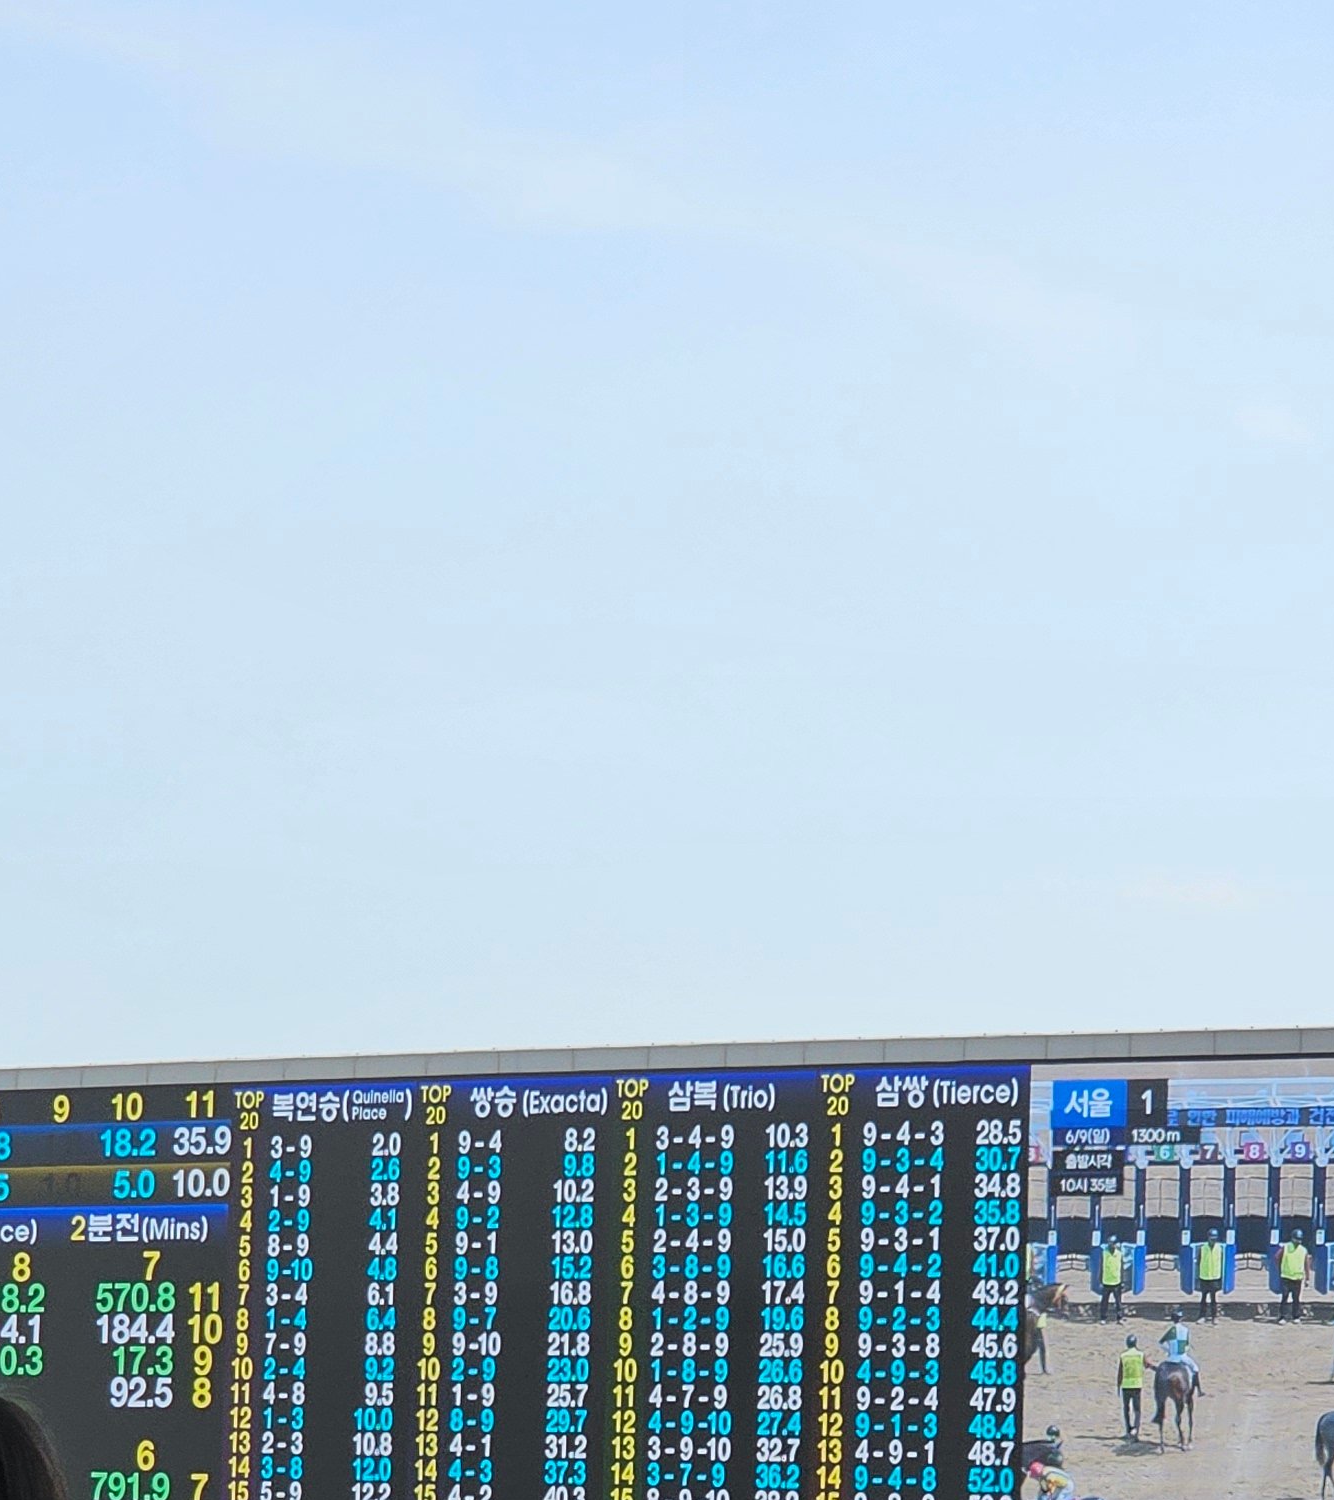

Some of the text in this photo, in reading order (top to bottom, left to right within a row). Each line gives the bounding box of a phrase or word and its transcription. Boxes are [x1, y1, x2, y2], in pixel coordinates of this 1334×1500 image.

[54, 1095, 70, 1123] 9
[112, 1092, 142, 1120] 10
[186, 1090, 213, 1118] 11
[235, 1091, 404, 1109] TOP Quinella
[471, 1087, 608, 1118] 쌍승 (Exacta)
[668, 1080, 775, 1112] 삼복 (Trio)
[875, 1076, 1019, 1108] 삼쌍 (Tierce)
[1064, 1089, 1152, 1118] 서울 1
[352, 1107, 387, 1119] Place
[100, 1129, 156, 1157] 18.2
[173, 1126, 231, 1155] 35.9
[372, 1132, 401, 1156] 2.0
[564, 1127, 595, 1152] 8.2
[766, 1123, 808, 1148] 10.3
[976, 1119, 1021, 1145] 28.5
[1066, 1128, 1110, 1144] 6/9(일)
[113, 1170, 155, 1198] 5.0
[172, 1168, 230, 1196] 10.0
[974, 1226, 1020, 1251] 37.0
[96, 1282, 175, 1313] 570.8
[96, 1313, 175, 1344] 184.4
[110, 1376, 173, 1408] 92.5
